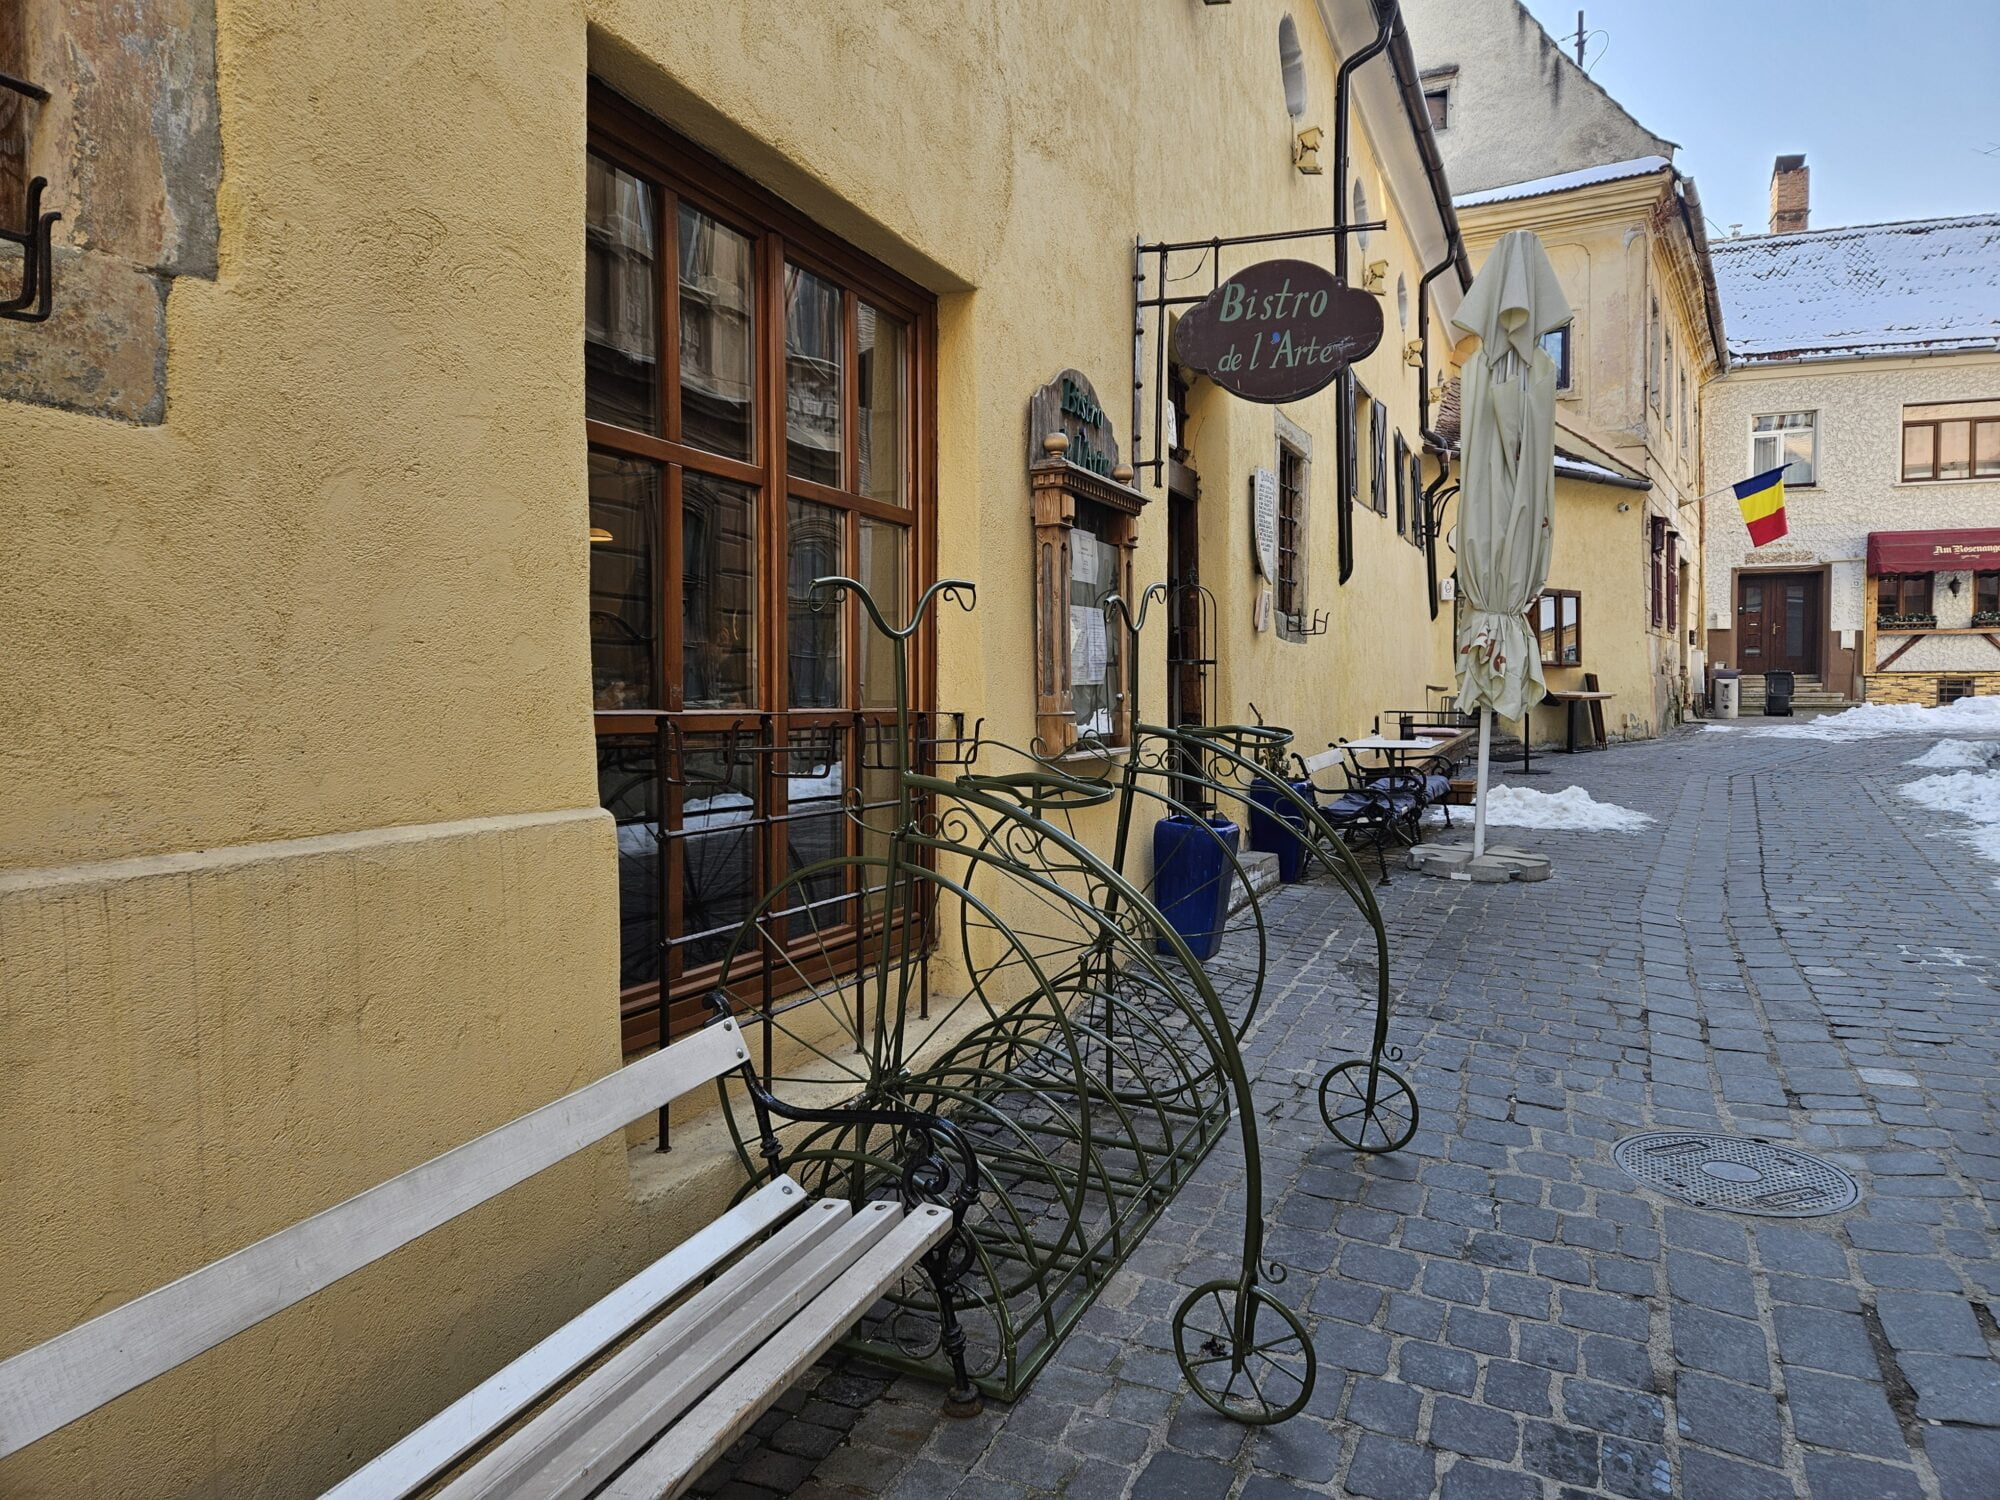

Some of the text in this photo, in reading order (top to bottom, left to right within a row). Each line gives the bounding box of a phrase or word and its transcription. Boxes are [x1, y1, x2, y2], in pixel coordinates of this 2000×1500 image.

[1219, 278, 1328, 322] Bistro
[1218, 344, 1242, 371] de
[1060, 378, 1104, 430] Bistro
[1933, 545, 1952, 555] Am
